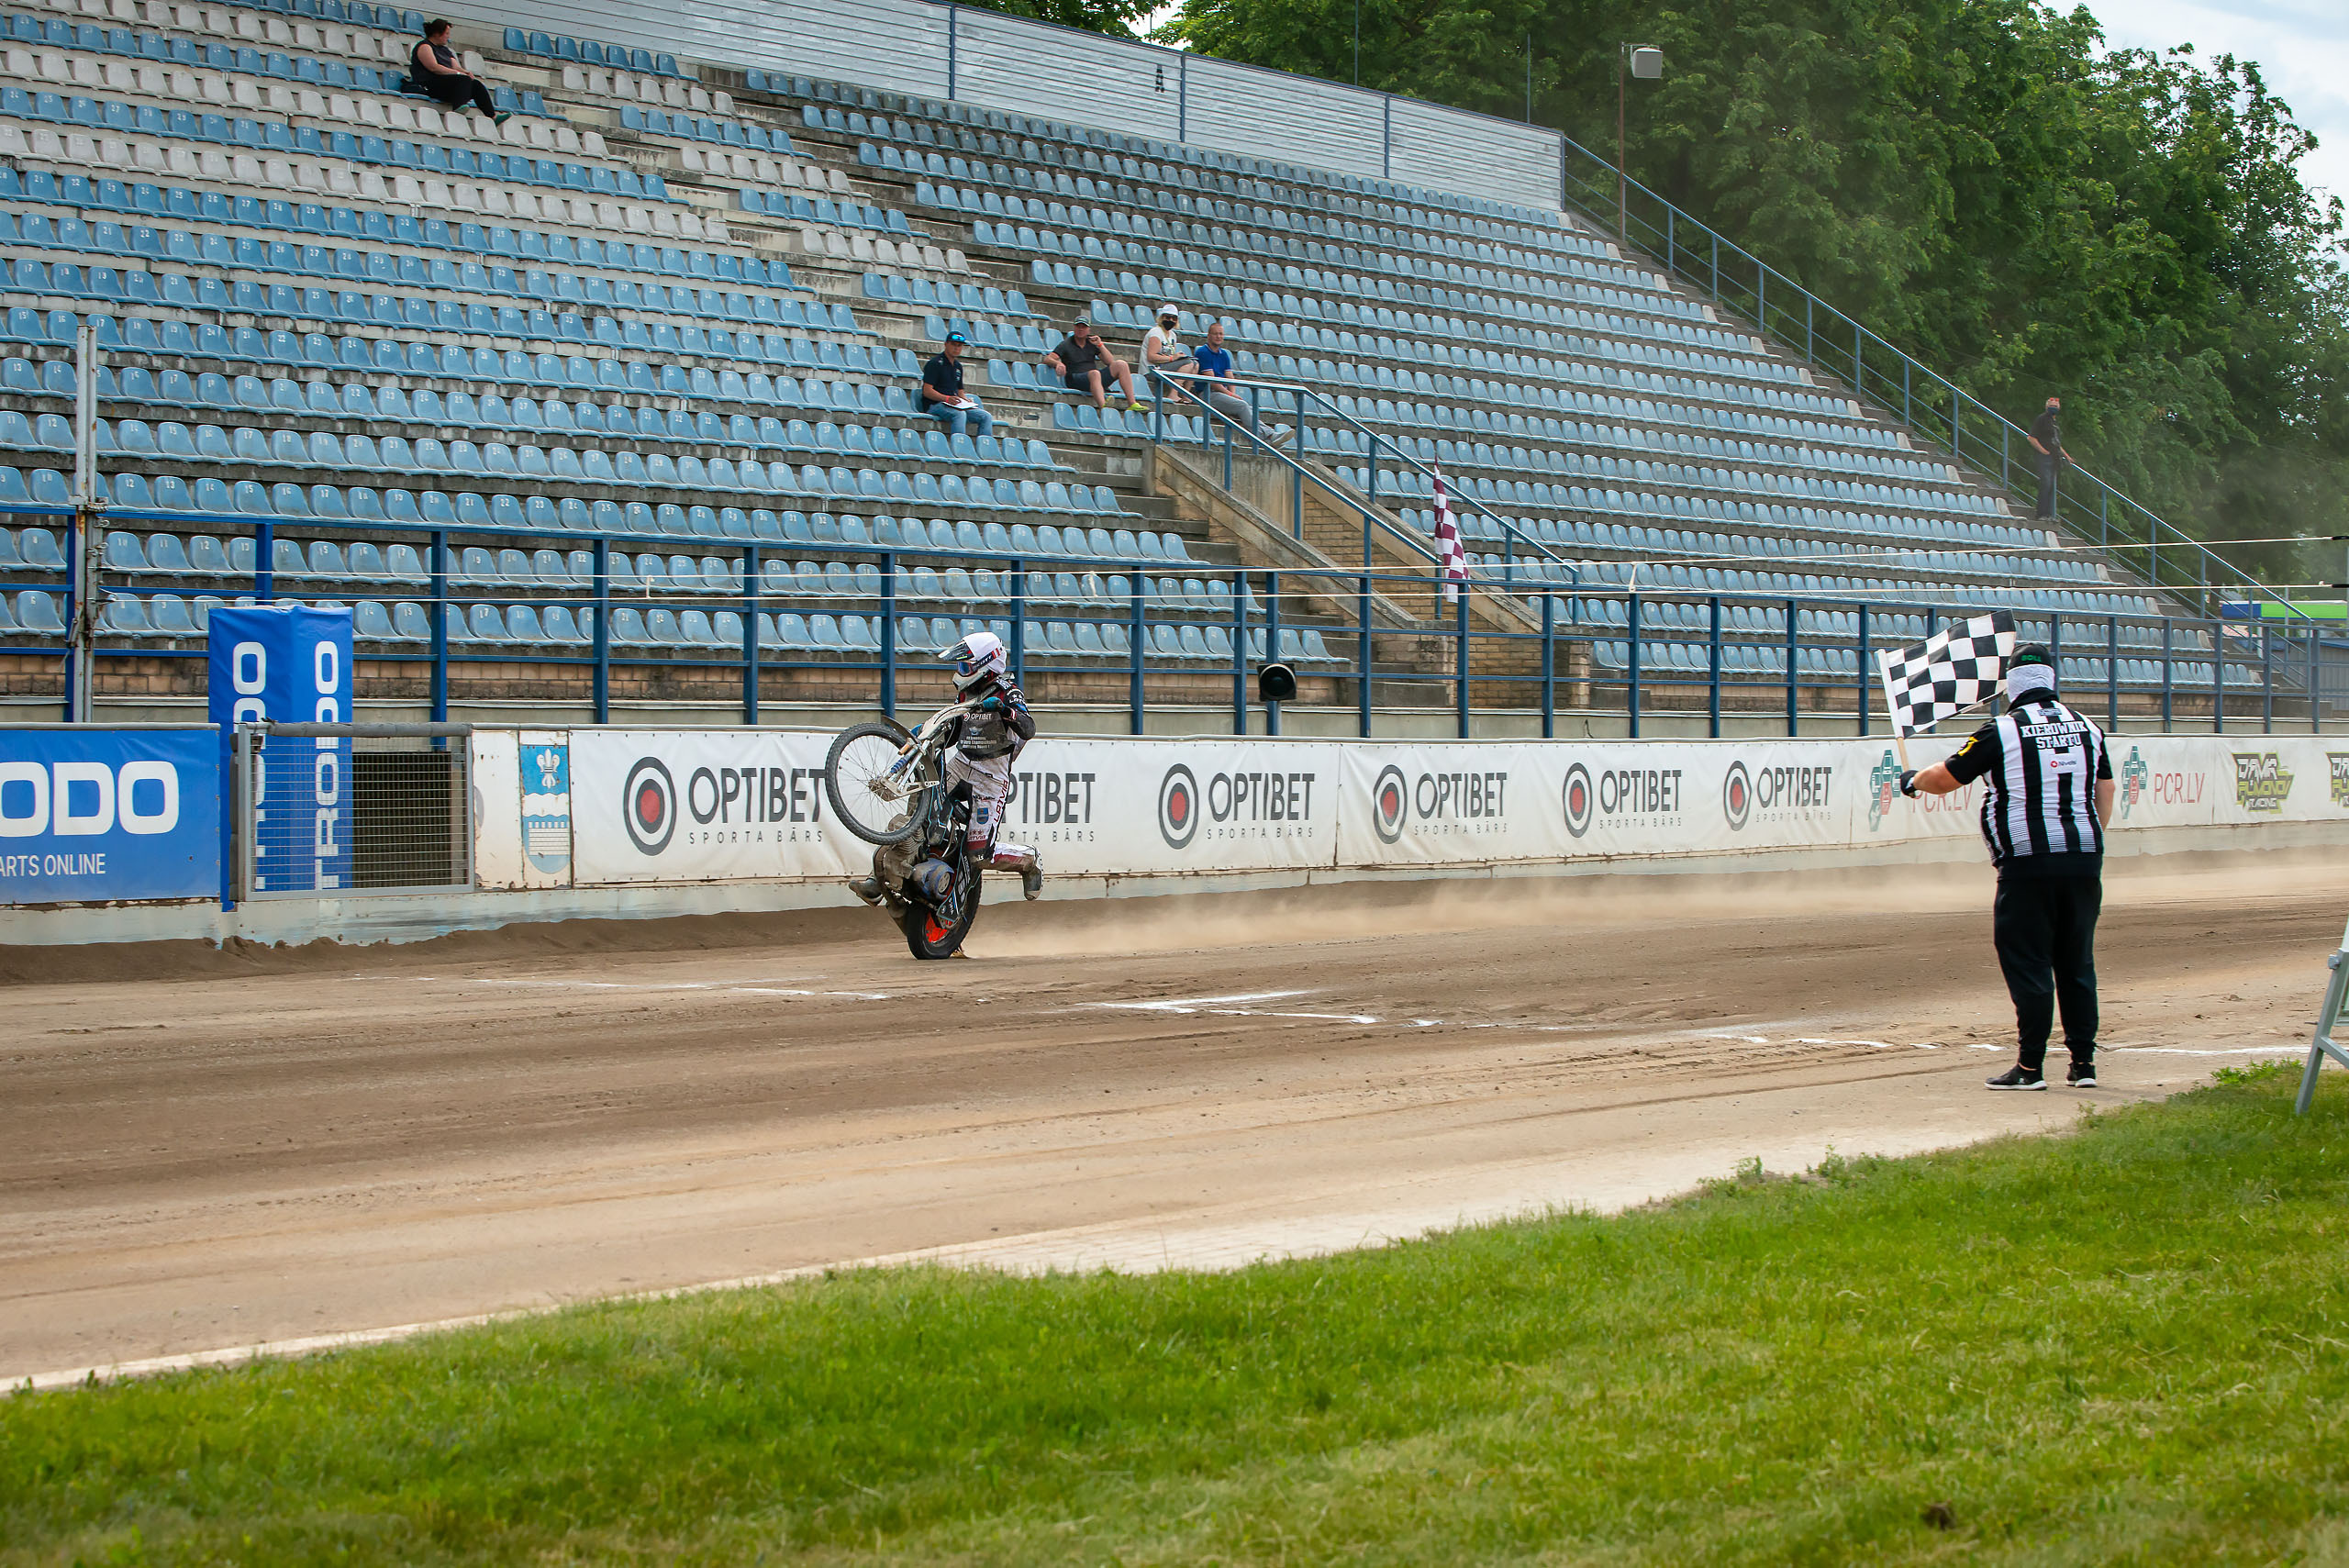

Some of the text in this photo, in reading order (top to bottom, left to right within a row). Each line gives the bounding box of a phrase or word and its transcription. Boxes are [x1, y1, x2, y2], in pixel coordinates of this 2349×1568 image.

[2021, 721, 2087, 738] KIEROWNIK
[2036, 733, 2081, 750] STARTU
[0, 761, 180, 838] ODO
[689, 767, 826, 824] OPTIBET
[1208, 773, 1315, 823] OPTIBET
[1417, 772, 1508, 819] OPTIBET
[1600, 769, 1682, 814] OPTIBET
[1756, 766, 1832, 807] OPTIBET
[2154, 773, 2205, 804] PCR.LV
[994, 780, 1008, 822] LATVIA
[690, 827, 822, 844] SPORTA BĀRS
[1052, 827, 1095, 842] BĀRS
[1208, 824, 1313, 840] SPORTA BĀRS
[1415, 819, 1508, 836] SPORTA BĀRS
[1599, 817, 1645, 828] SPORTA
[44, 853, 106, 876] ONLINE
